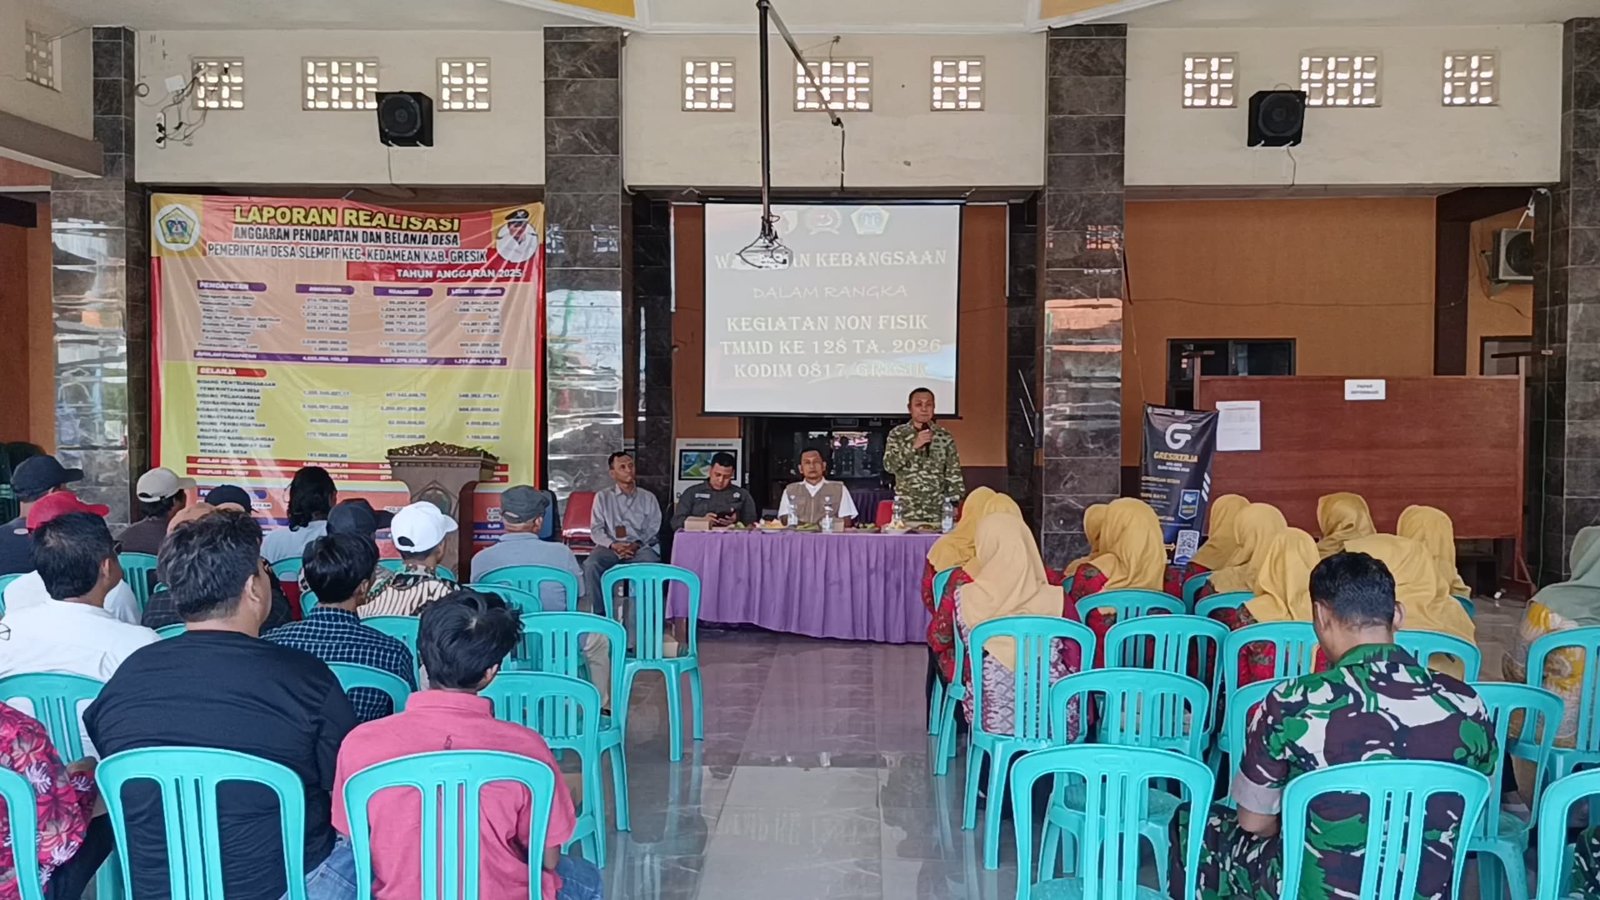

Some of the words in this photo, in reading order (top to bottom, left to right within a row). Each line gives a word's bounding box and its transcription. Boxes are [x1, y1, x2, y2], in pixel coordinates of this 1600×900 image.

[234, 205, 338, 226] LAPORAN
[343, 208, 460, 231] REALISASI
[233, 226, 290, 241] ANGGARAN
[293, 228, 359, 243] PENDAPATAN
[362, 231, 382, 244] DAN
[384, 232, 429, 245] BELANJA
[431, 234, 459, 246] DESA
[207, 243, 268, 257] PEMERINTAH
[271, 245, 296, 258] DESA
[299, 246, 339, 259] SLEMPIT
[342, 248, 364, 260] KEC.
[367, 249, 421, 262] KEDAMEAN
[423, 250, 448, 262] KAB.
[450, 250, 486, 263] GRESIK
[815, 250, 947, 268] KEBANGSAAN
[396, 269, 433, 278] TAHUN
[436, 269, 495, 278] ANGGARAN
[753, 286, 821, 299] DALAM
[824, 285, 908, 299] RANGKA
[726, 316, 829, 332] KEGIATAN
[835, 316, 872, 331] NON
[878, 315, 928, 330] FISIK
[720, 341, 773, 355] TMMD
[779, 340, 804, 355] KE
[811, 338, 847, 354] 128
[852, 339, 885, 354] TA.
[892, 338, 942, 354] 2026
[734, 364, 792, 378] KODIM
